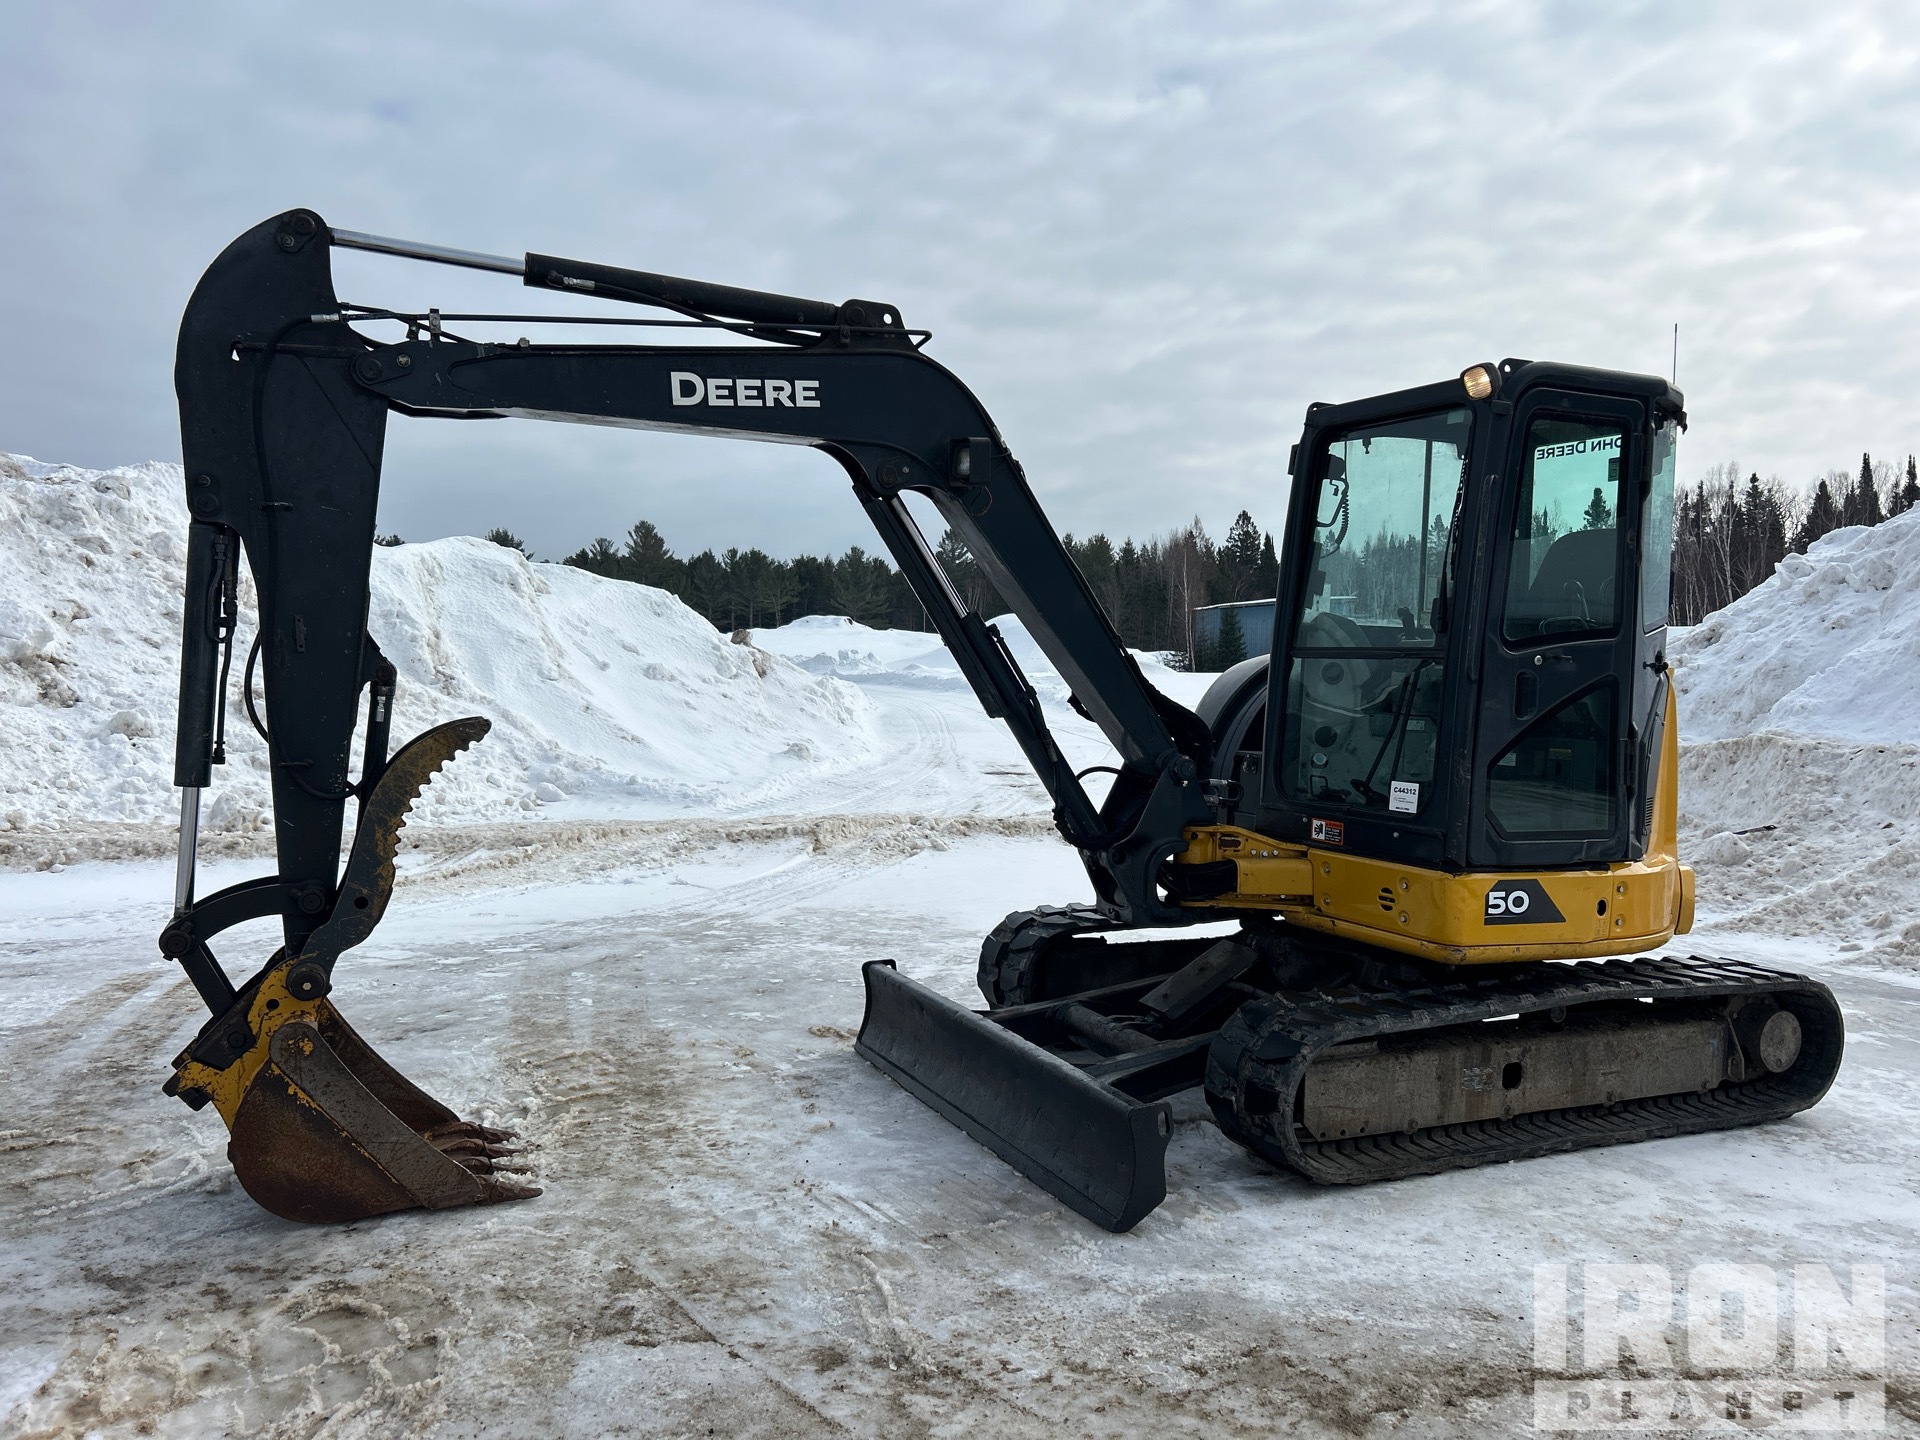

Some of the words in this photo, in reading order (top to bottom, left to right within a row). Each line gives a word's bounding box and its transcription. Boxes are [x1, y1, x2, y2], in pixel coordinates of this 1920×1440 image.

[670, 371, 821, 408] DEERE
[1393, 786, 1417, 796] C44312
[1487, 890, 1530, 914] 50
